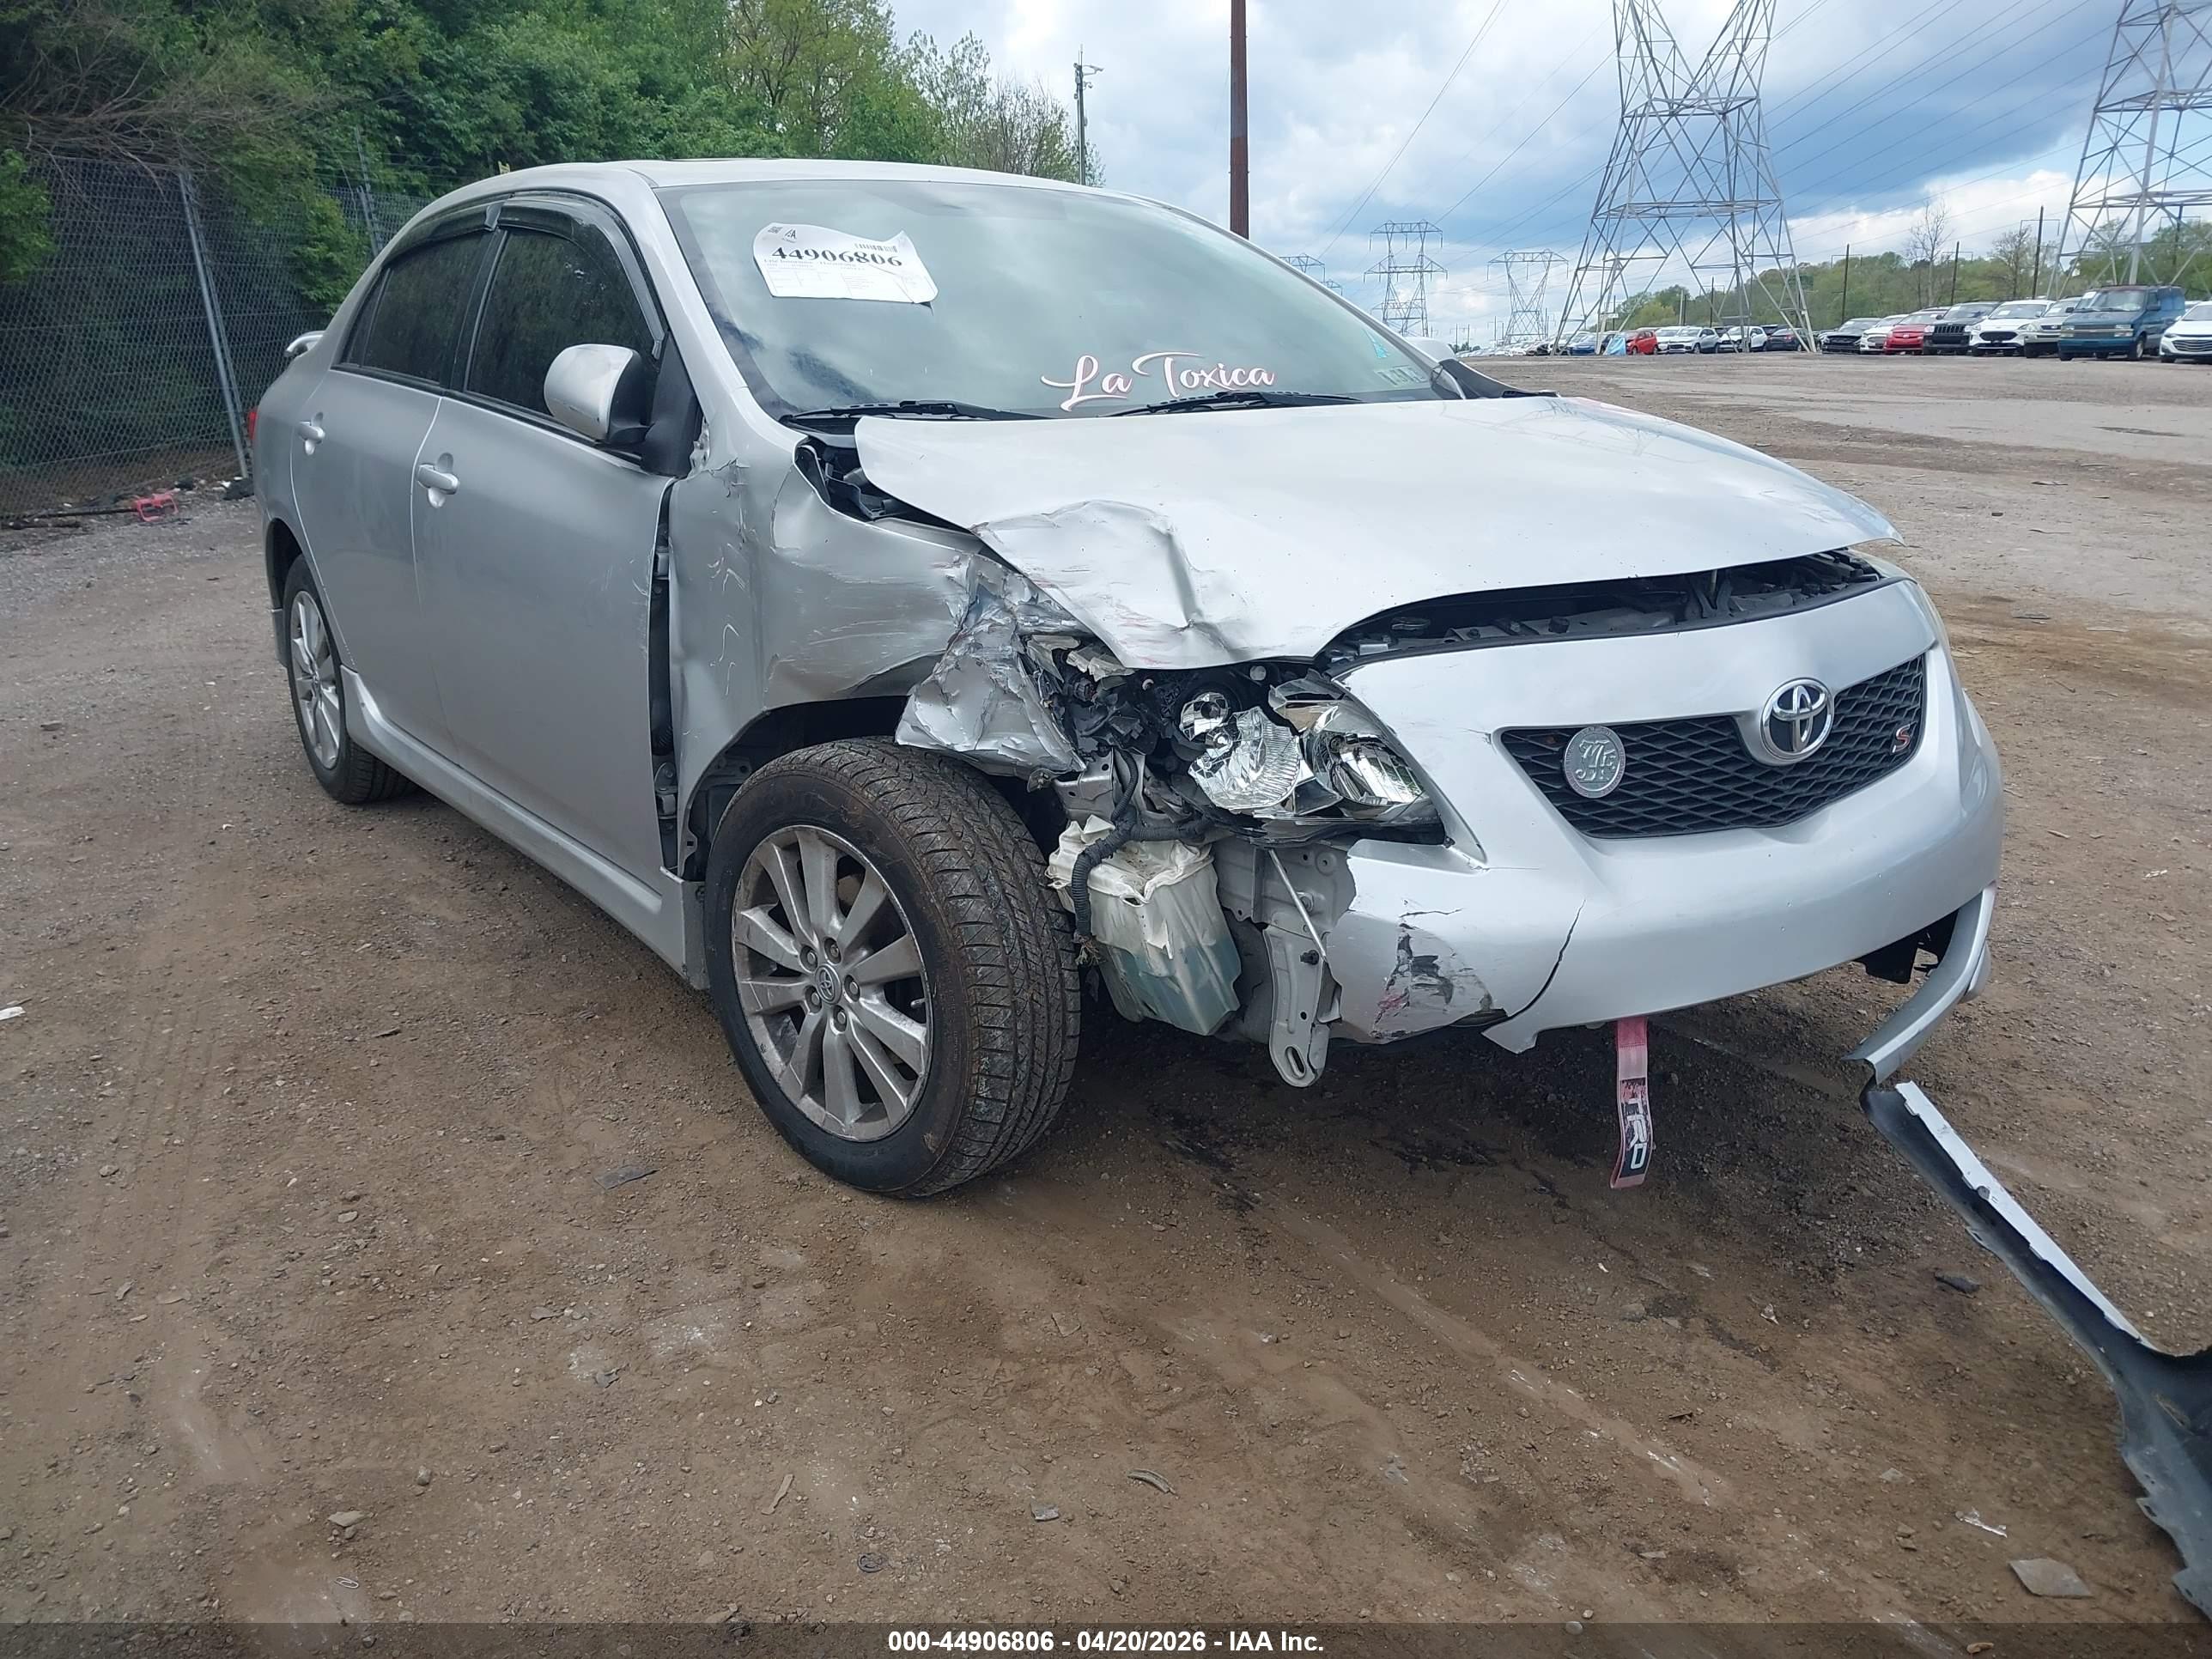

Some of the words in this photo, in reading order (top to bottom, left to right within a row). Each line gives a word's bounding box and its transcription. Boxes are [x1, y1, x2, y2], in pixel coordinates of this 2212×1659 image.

[771, 246, 902, 267] 44906806
[1040, 355, 1133, 412] La
[1132, 351, 1275, 398] Toxica
[1892, 724, 1911, 753] S
